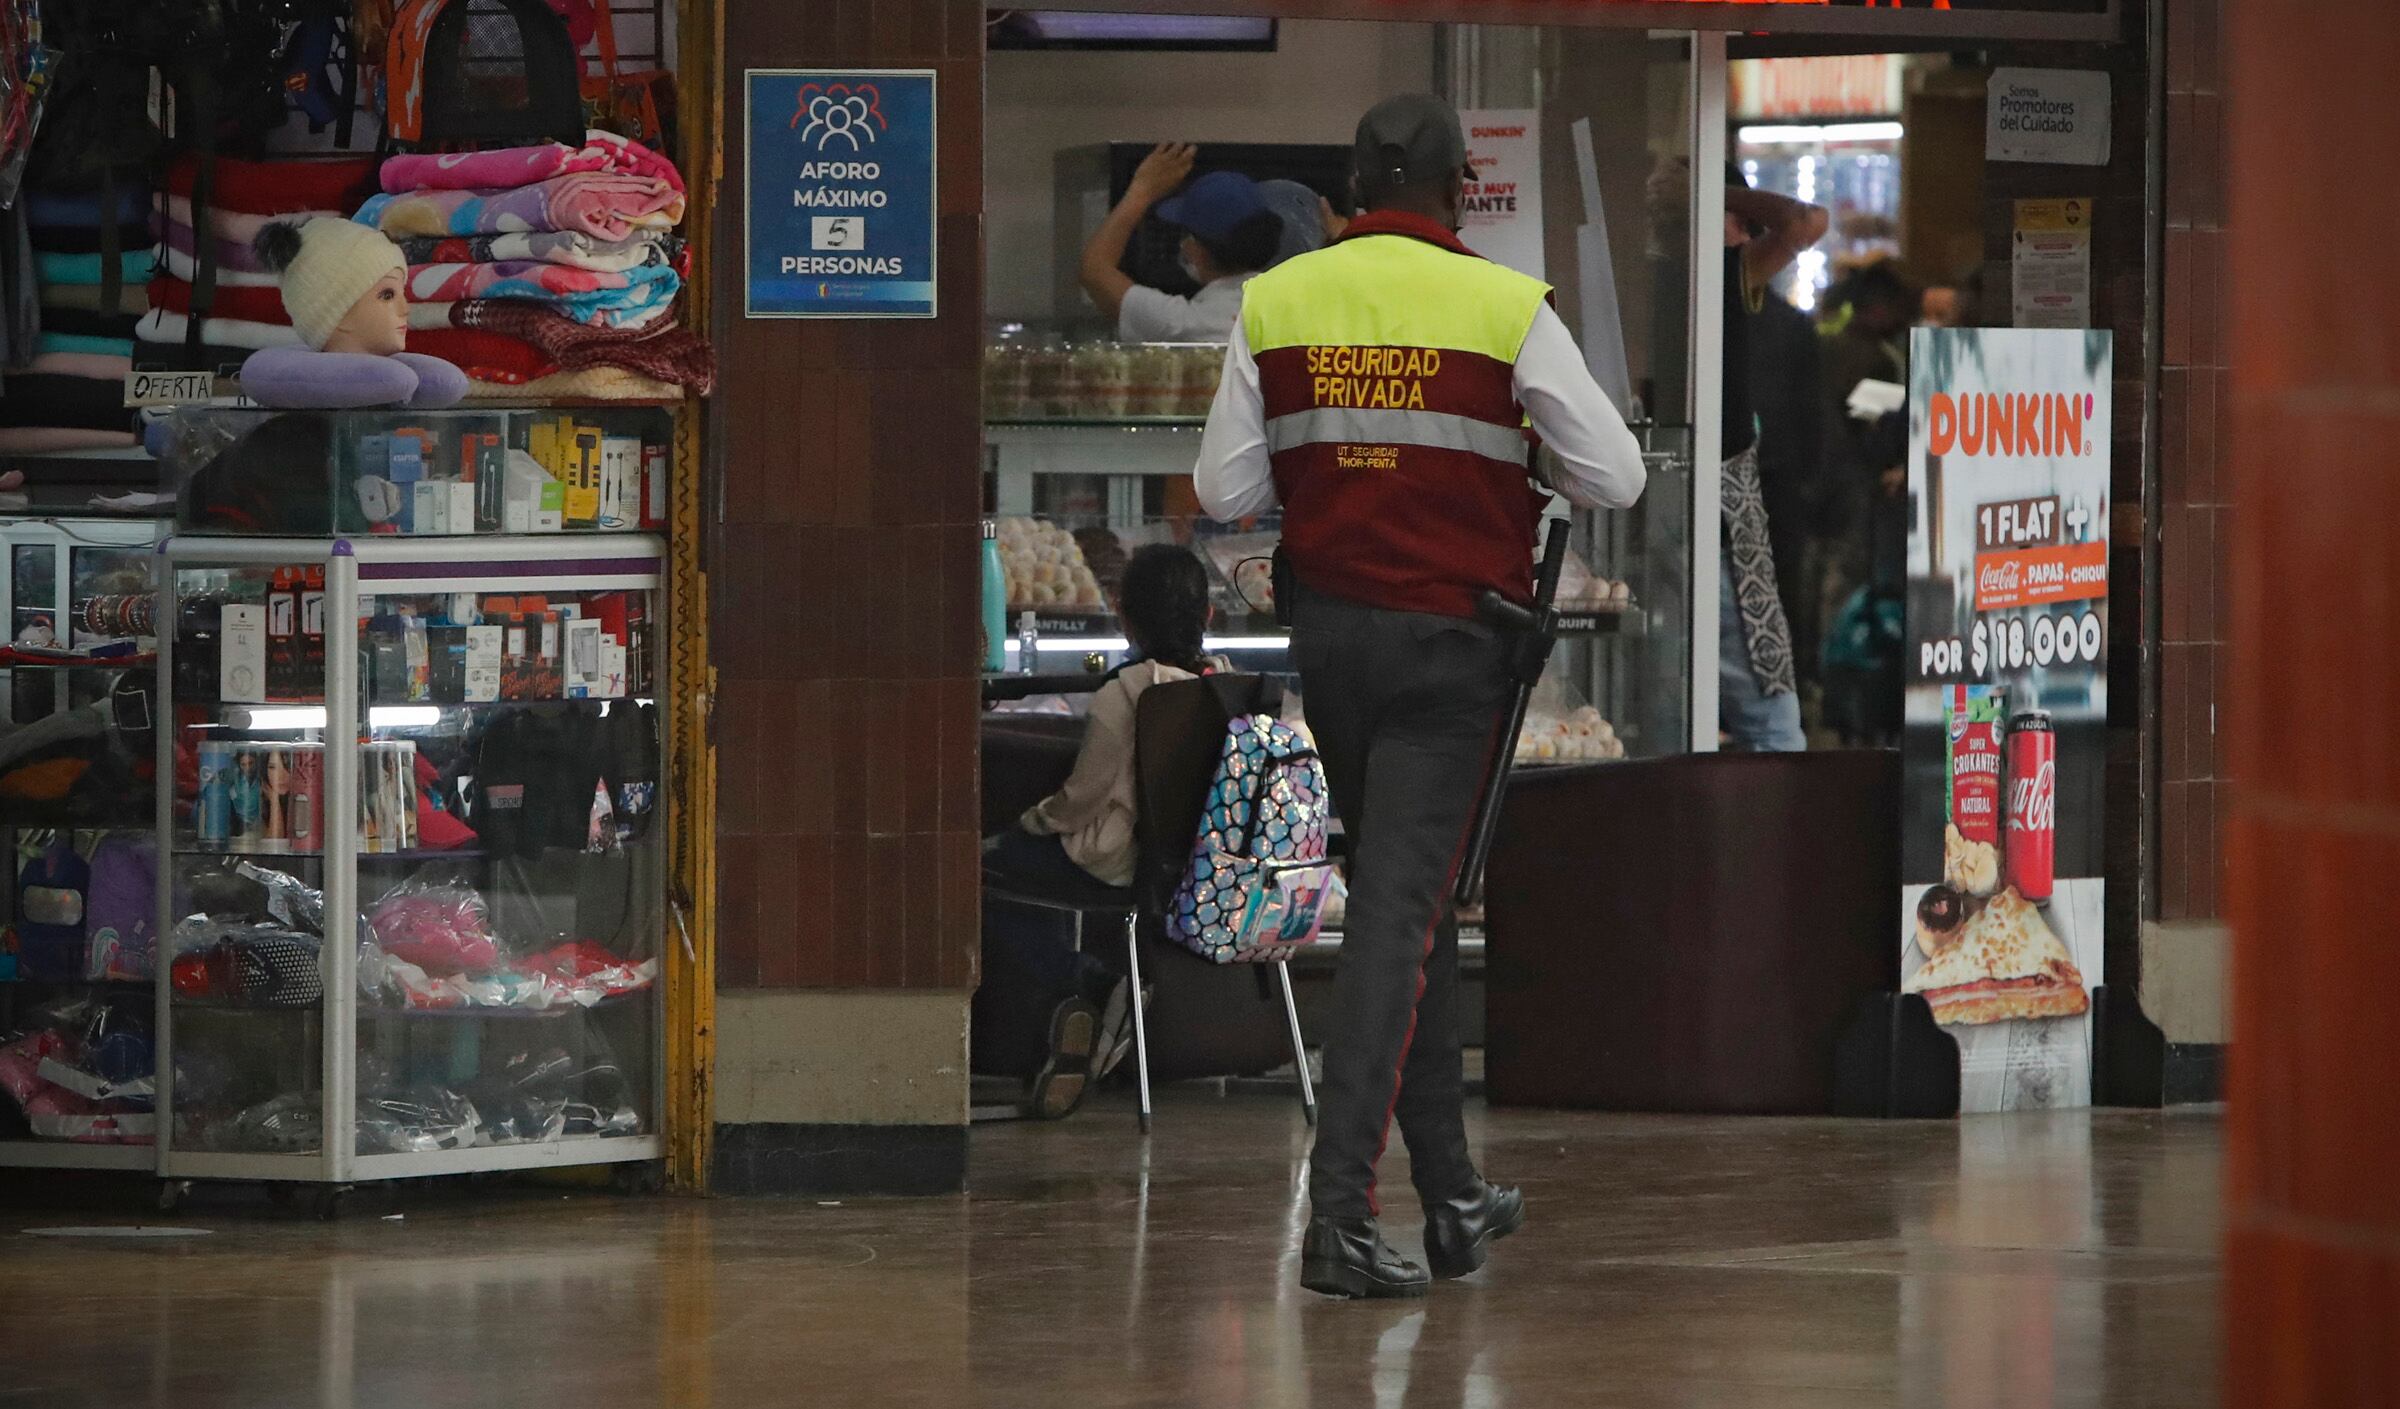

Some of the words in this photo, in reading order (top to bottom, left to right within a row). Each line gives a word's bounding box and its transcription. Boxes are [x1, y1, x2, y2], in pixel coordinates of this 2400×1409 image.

[2009, 85, 2039, 97] Somos
[2000, 96, 2075, 115] Promotores
[1471, 126, 1526, 138] DUNKIN'
[2000, 114, 2019, 130] del
[2021, 115, 2074, 133] Cuidado
[800, 162, 880, 180] AFORO
[794, 186, 887, 208] MÁXIMO
[1484, 183, 1516, 195] MUY
[1466, 196, 1516, 212] ANTE
[827, 218, 850, 247] 5
[781, 256, 902, 275] PERSONAS
[1306, 346, 1441, 377] SEGURIDAD
[134, 375, 209, 399] OFERTA
[1314, 377, 1425, 409] PRIVADA
[1930, 392, 2093, 456] DUNKIN'
[1337, 446, 1348, 456] UT
[1352, 447, 1399, 457] SEGURIDAD
[1337, 457, 1397, 468] THOR-PENTA
[1981, 507, 1992, 545] 1
[1998, 501, 2054, 543] FLAT
[2028, 562, 2064, 584] PAPAS
[2071, 565, 2105, 583] CHIQUI
[1015, 619, 1087, 631] CANTILLY
[1557, 618, 1597, 630] QUIPE
[1921, 640, 1962, 676] POR
[1996, 612, 2101, 669] 18.000
[1969, 738, 1986, 751] SUPER
[1954, 753, 2000, 776] CROKANTES
[1961, 797, 1991, 814] NATURAL
